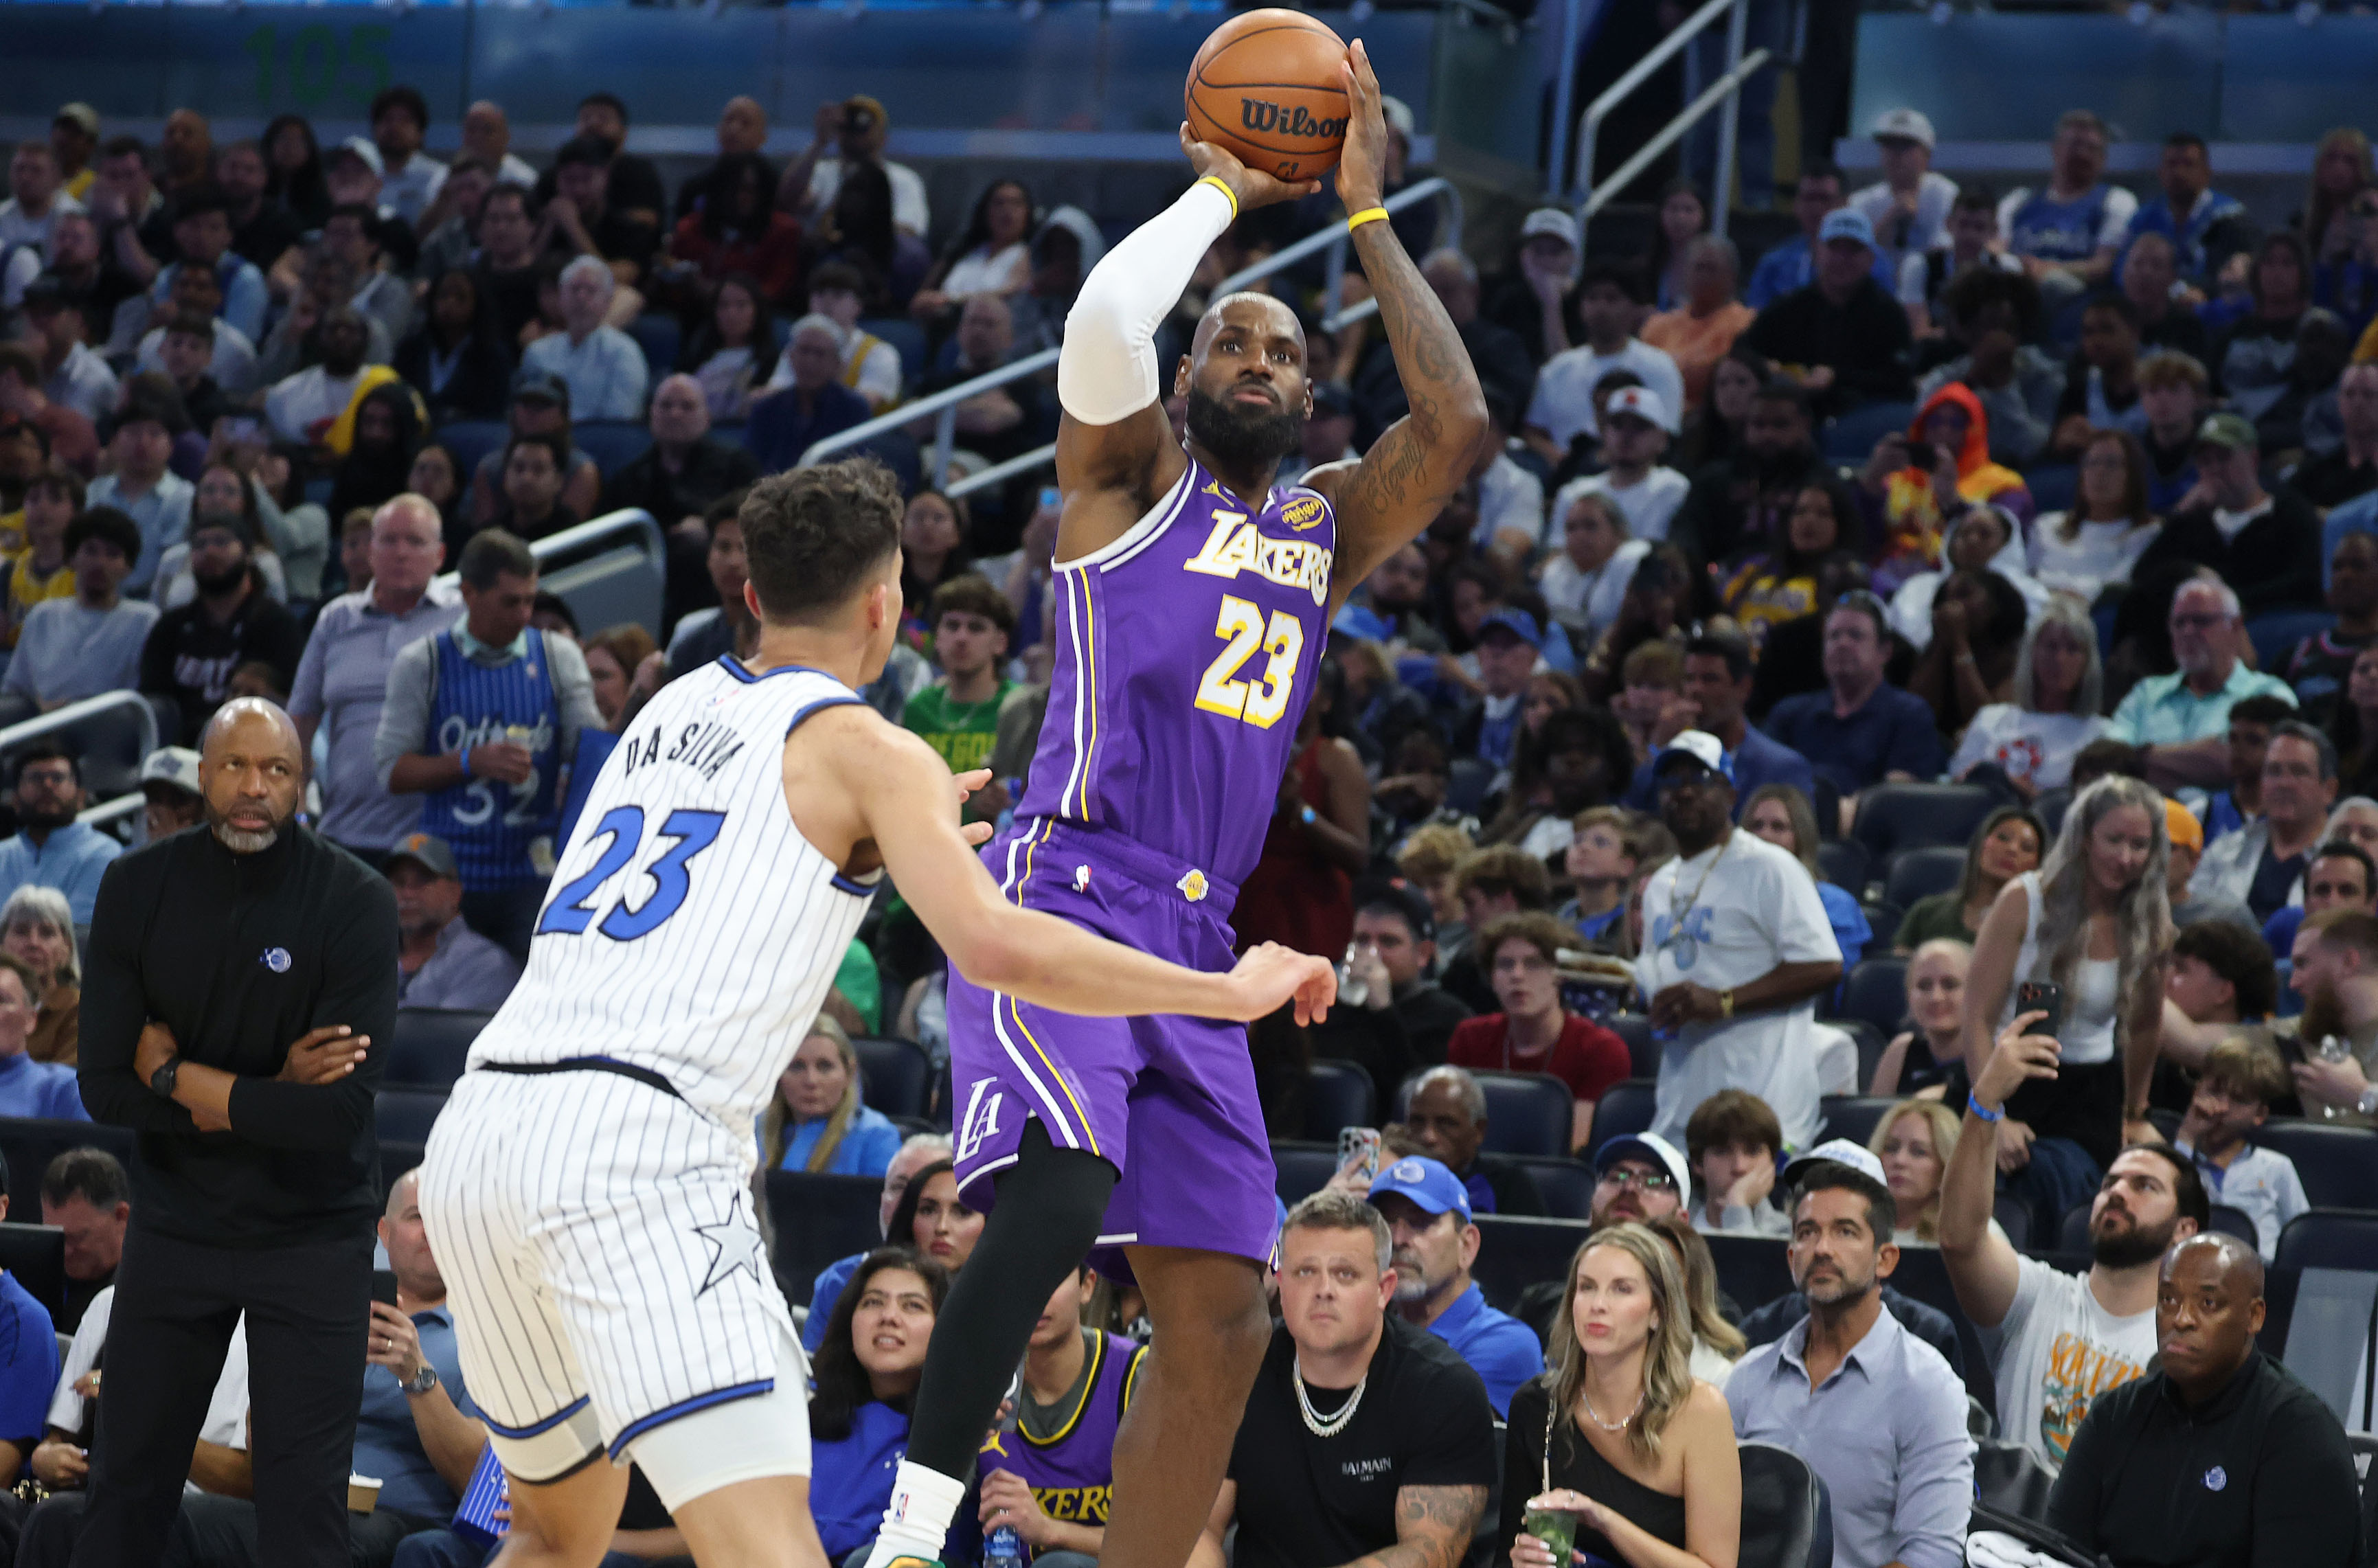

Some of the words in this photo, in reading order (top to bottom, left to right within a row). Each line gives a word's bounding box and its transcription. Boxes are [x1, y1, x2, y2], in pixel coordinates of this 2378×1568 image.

[245, 22, 391, 105] 105
[1184, 508, 1331, 607] LAKERS
[1194, 593, 1304, 729] 23
[452, 767, 539, 826] 32
[625, 725, 661, 779] DA
[667, 722, 745, 782] SILVA
[534, 804, 728, 942] 23
[953, 1076, 1003, 1166] LA
